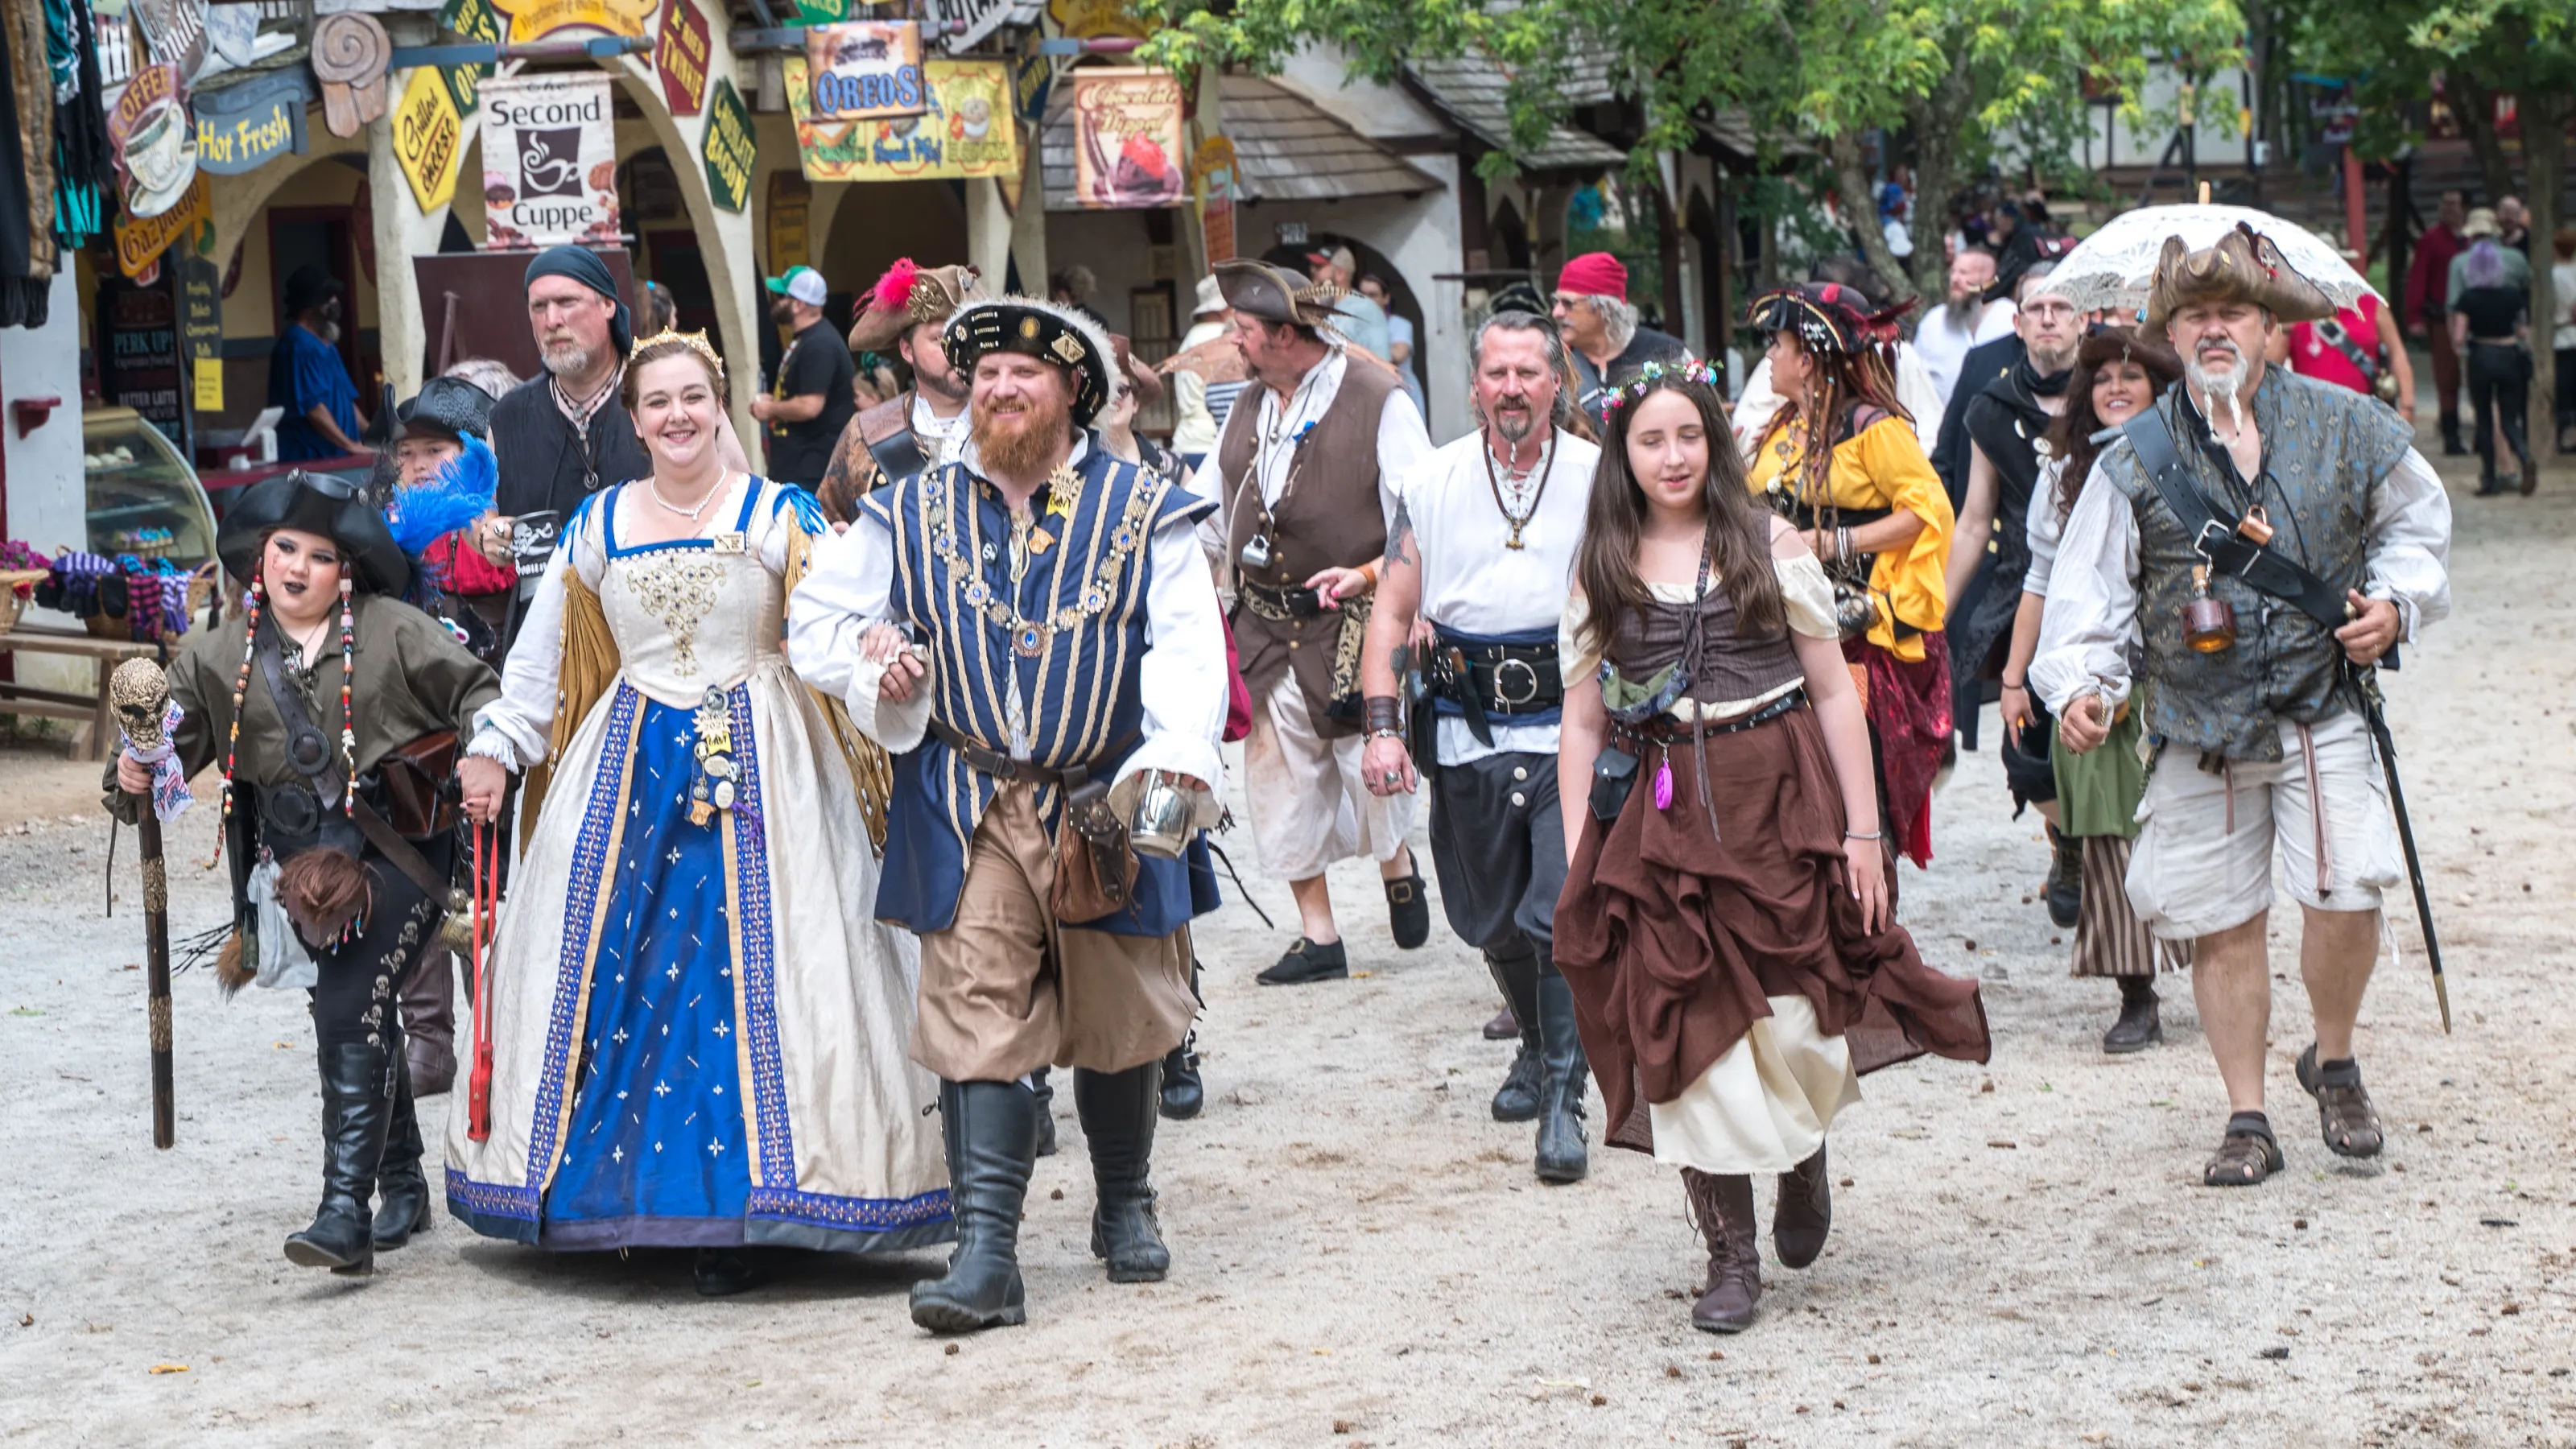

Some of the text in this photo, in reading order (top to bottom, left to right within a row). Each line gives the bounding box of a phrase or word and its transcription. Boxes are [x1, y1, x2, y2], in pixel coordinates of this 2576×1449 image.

[114, 66, 172, 137] COFFEE
[489, 94, 601, 127] Second
[816, 64, 919, 114] OREOS
[197, 103, 291, 164] Hot Fresh
[403, 86, 440, 163] Grilled
[705, 122, 748, 212] BACON
[512, 202, 593, 232] Cuppe
[113, 330, 175, 355] PERK UP!
